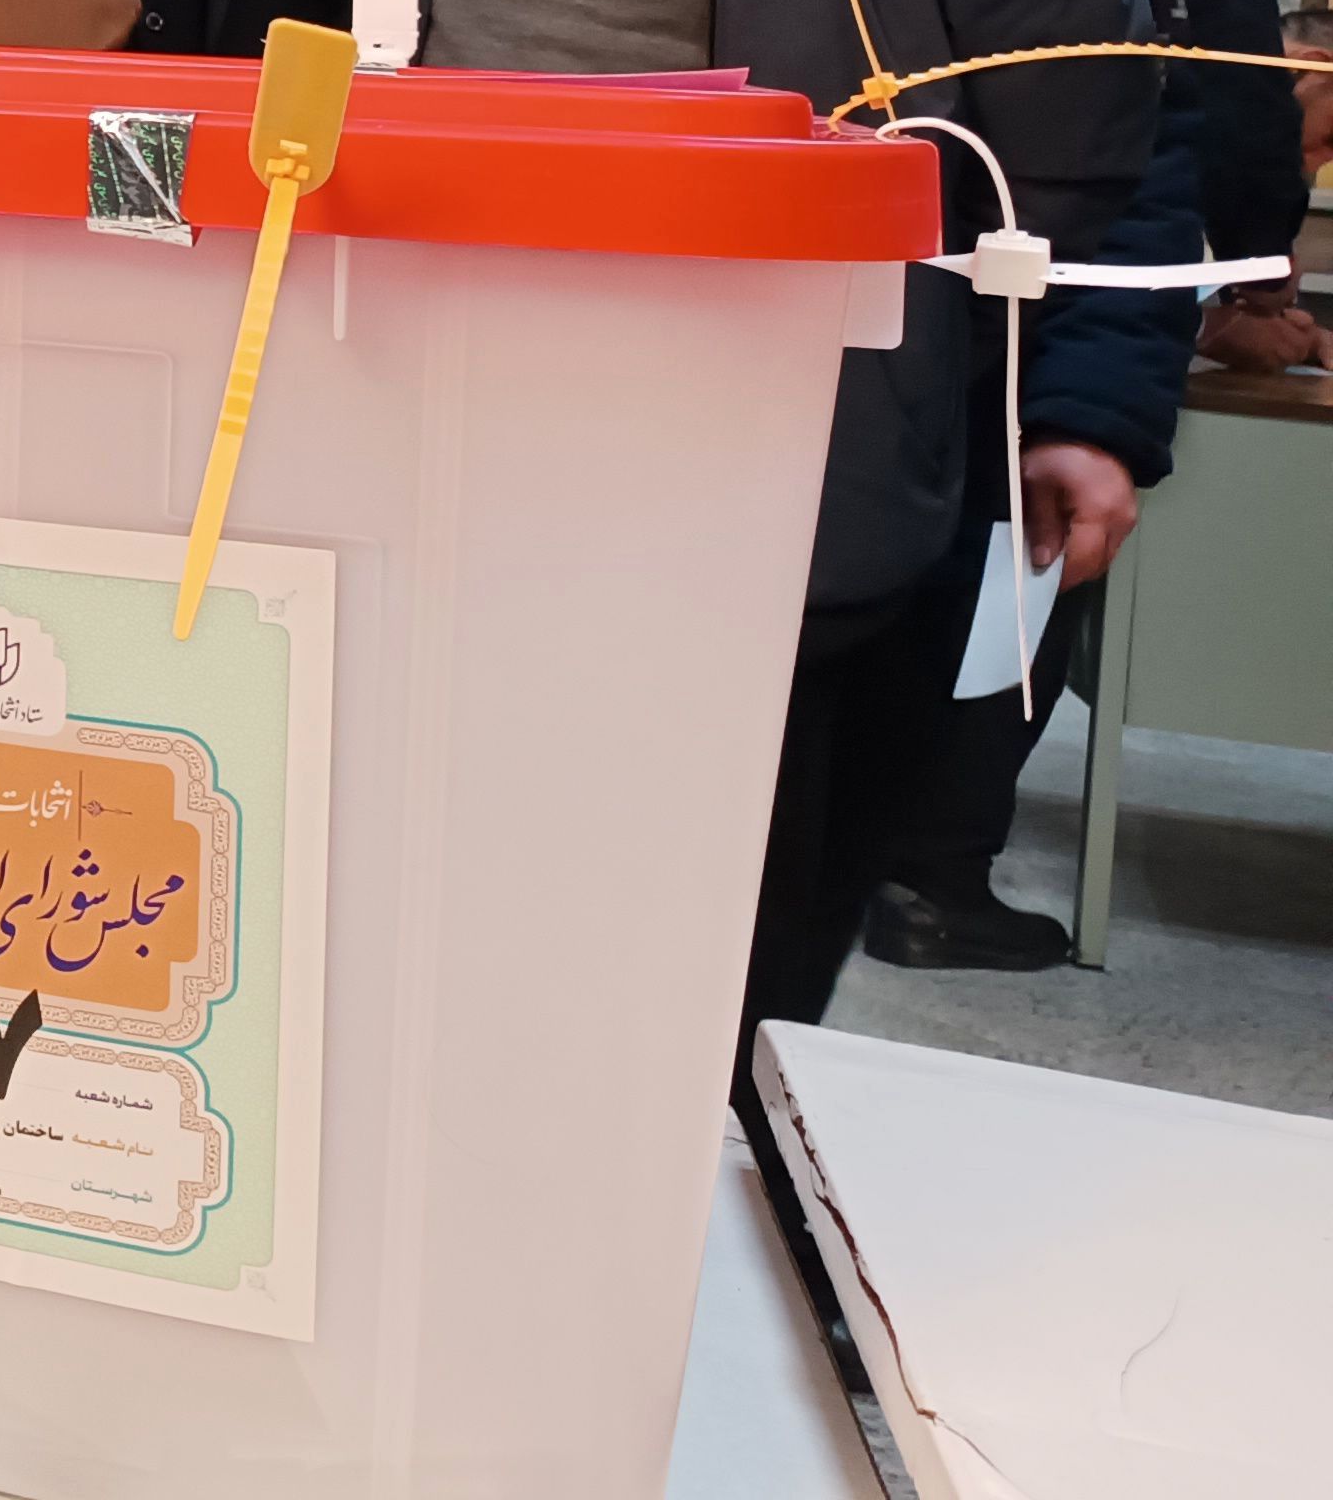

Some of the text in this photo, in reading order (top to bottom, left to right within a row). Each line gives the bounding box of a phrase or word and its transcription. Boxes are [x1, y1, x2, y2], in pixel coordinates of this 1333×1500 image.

[20, 703, 44, 724] ستاد
[45, 873, 185, 972] مجلس
[74, 1088, 154, 1111] شماره شعبه
[2, 1119, 64, 1141] ساختمان
[71, 1133, 154, 1157] نام شعبه
[70, 1177, 153, 1203] شهرستان
